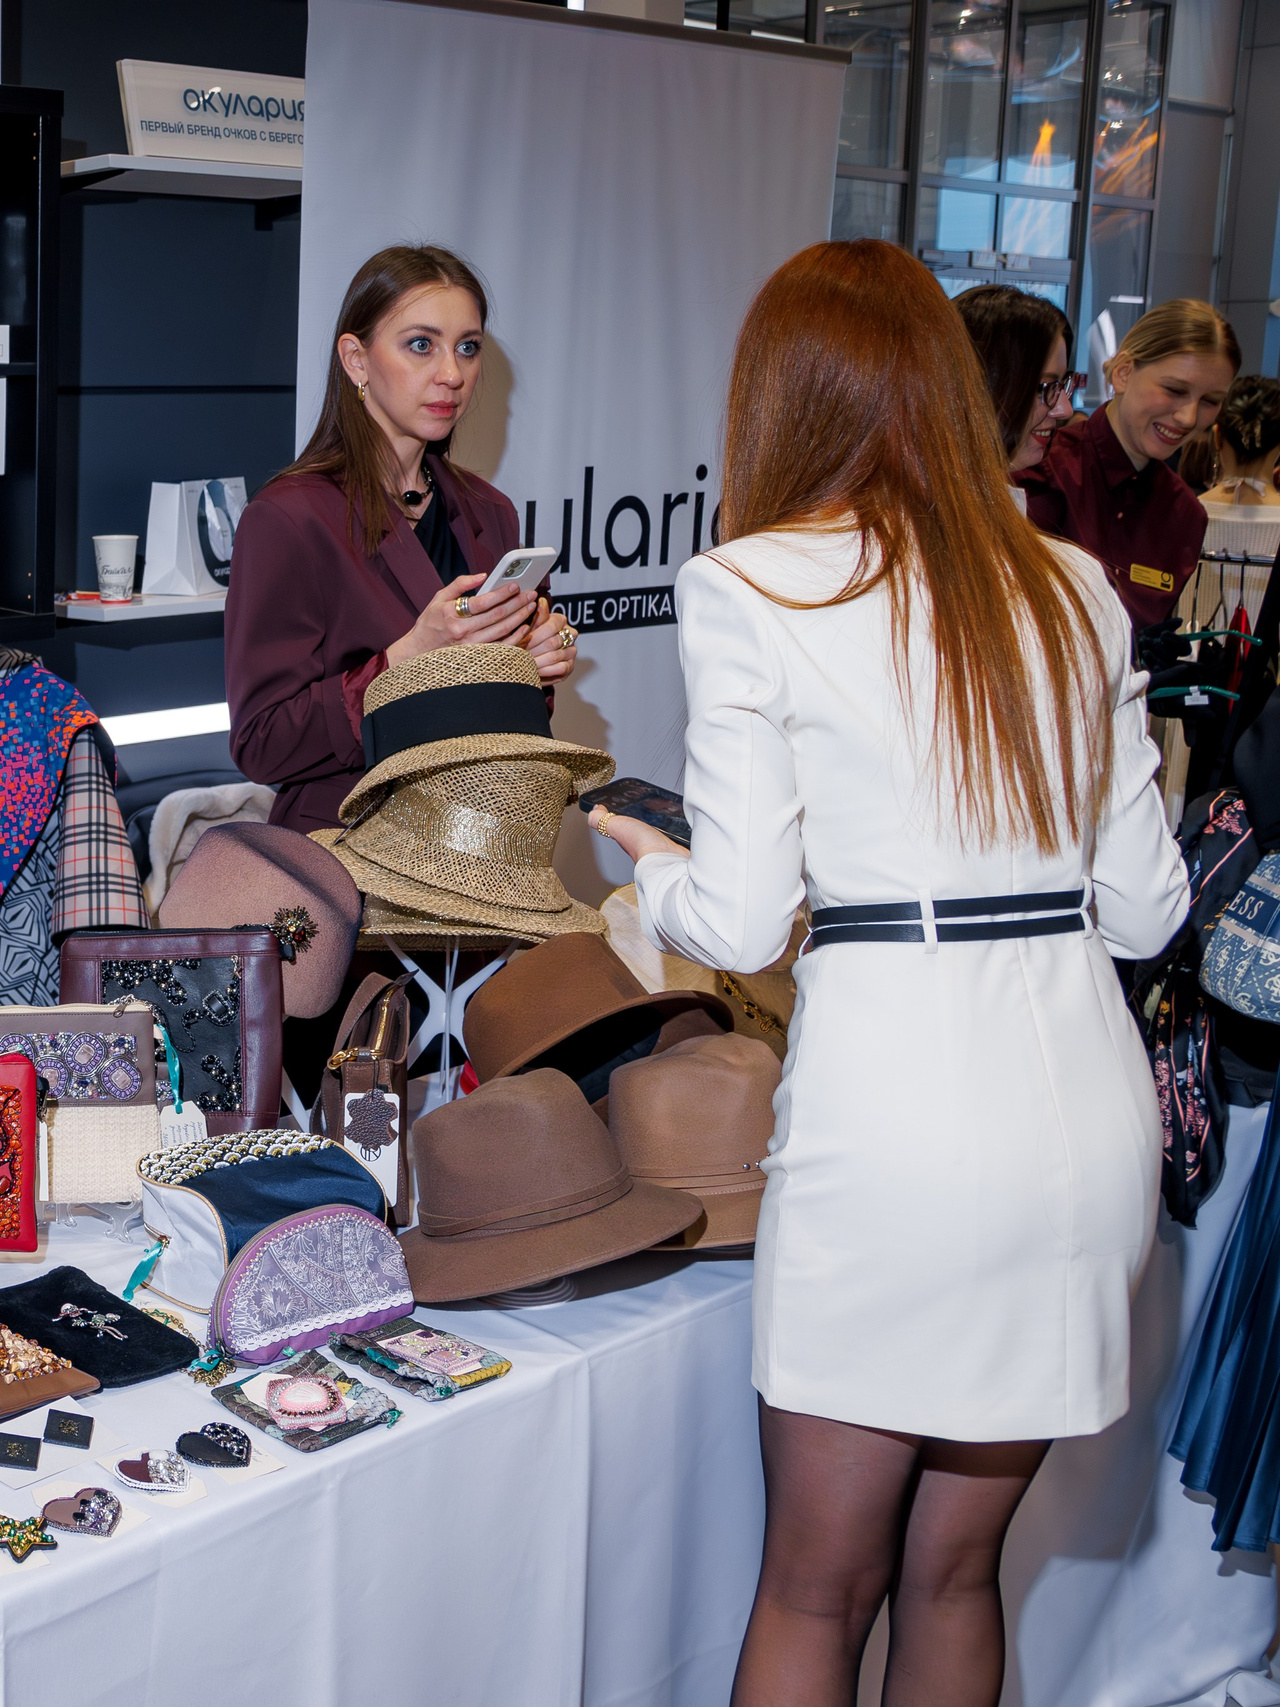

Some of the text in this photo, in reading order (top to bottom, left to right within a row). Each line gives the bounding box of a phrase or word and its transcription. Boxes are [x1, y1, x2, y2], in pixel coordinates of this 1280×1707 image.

[140, 120, 184, 134] ПЕРВЫЙ
[187, 124, 221, 139] БРЕНД
[223, 127, 257, 141] ОЧКОВ
[259, 130, 266, 141] С
[602, 593, 673, 623] OPTIKA
[1228, 890, 1265, 920] ESS
